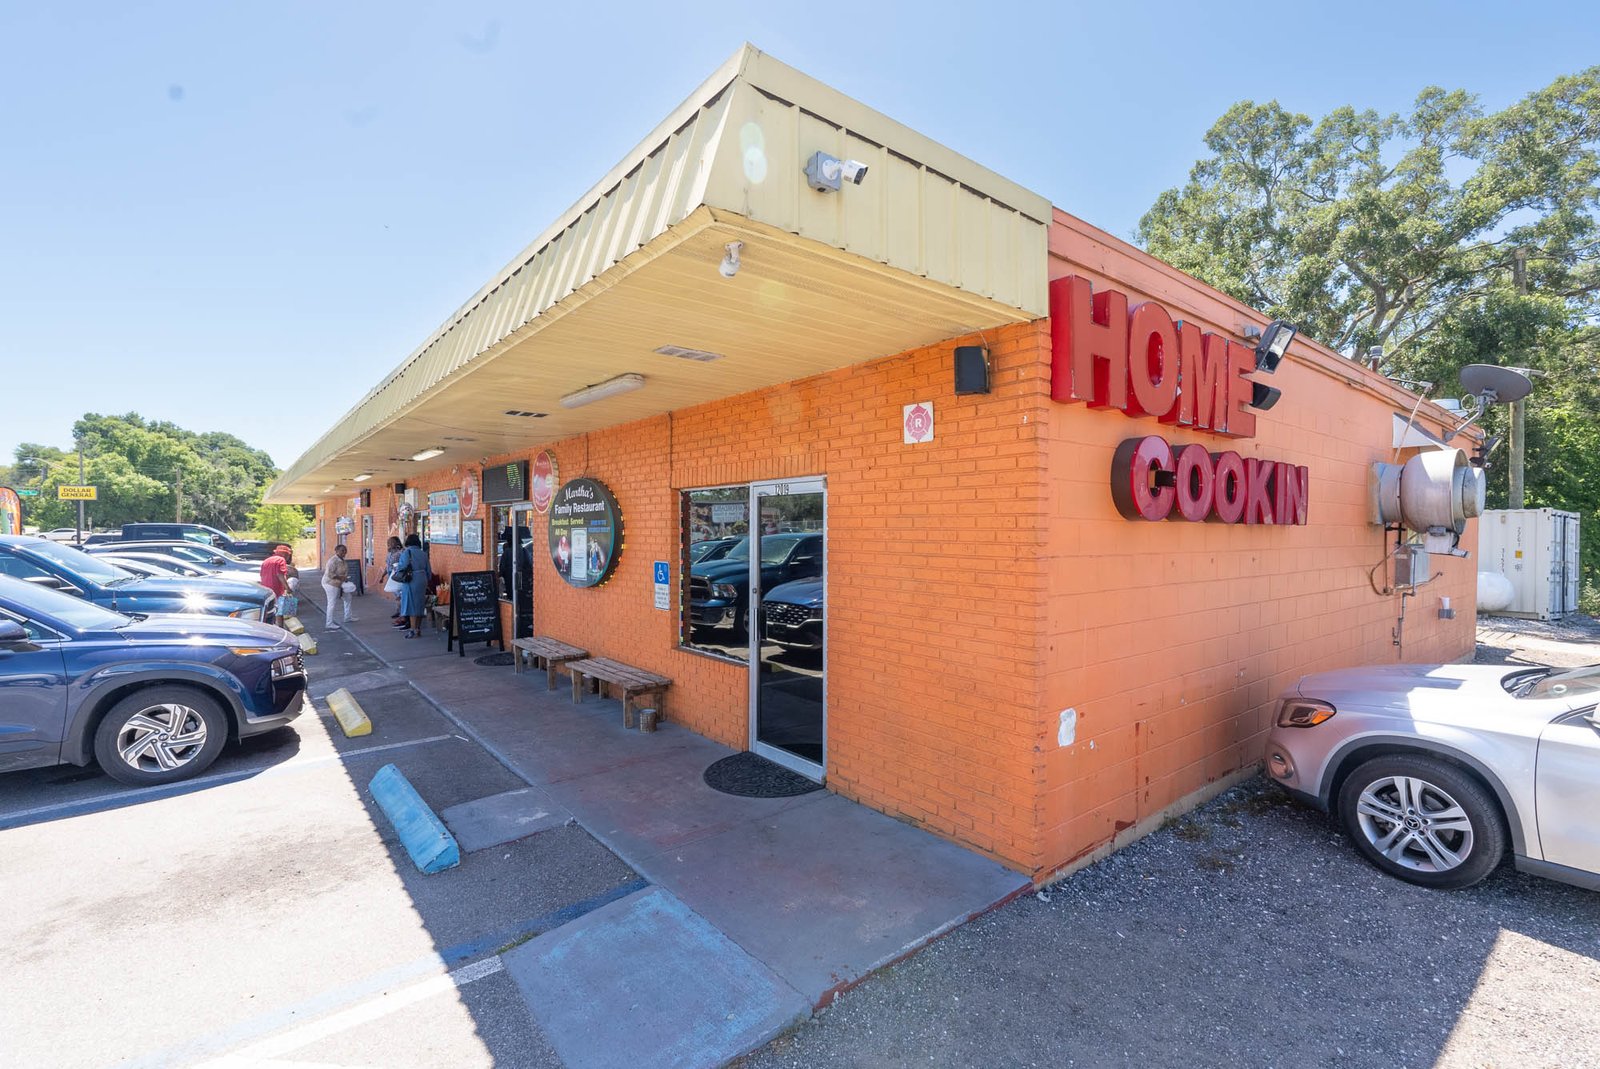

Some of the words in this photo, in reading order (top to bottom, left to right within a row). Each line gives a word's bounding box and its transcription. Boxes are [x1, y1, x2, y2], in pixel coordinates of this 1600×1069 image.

[1050, 274, 1257, 439] HOME
[915, 419, 922, 428] R
[1110, 435, 1309, 526] COOKIN
[563, 485, 594, 502] Martha's
[554, 504, 572, 516] Family
[573, 500, 605, 513] Restaurant
[570, 517, 584, 525] Served
